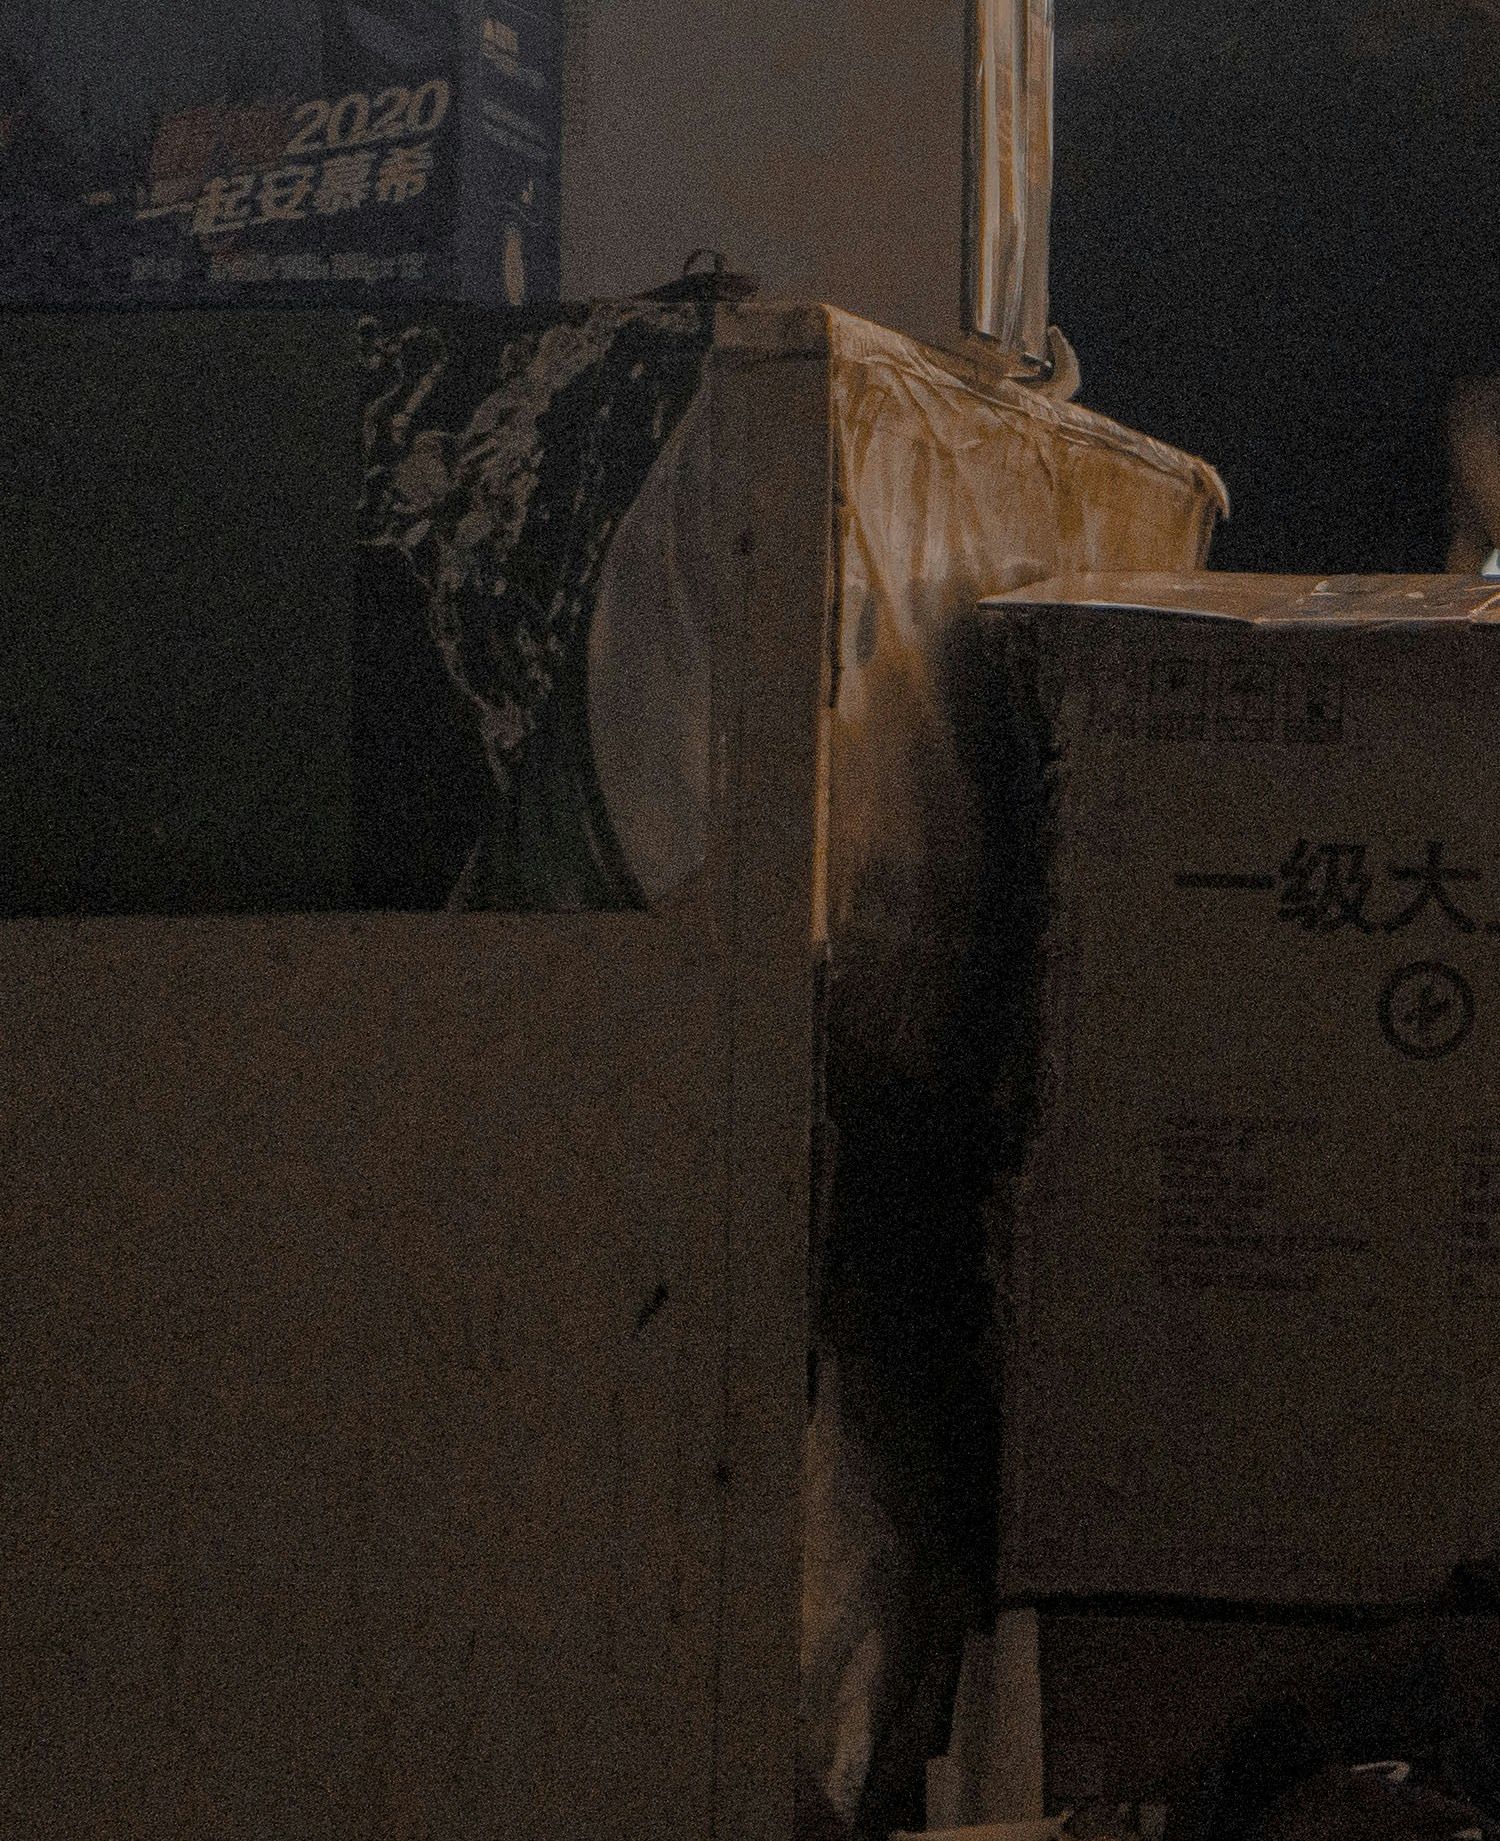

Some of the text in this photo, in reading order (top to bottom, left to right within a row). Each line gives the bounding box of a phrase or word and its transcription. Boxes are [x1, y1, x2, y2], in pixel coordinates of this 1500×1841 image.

[285, 78, 449, 154] 2020
[134, 143, 434, 237] 一起安慕希
